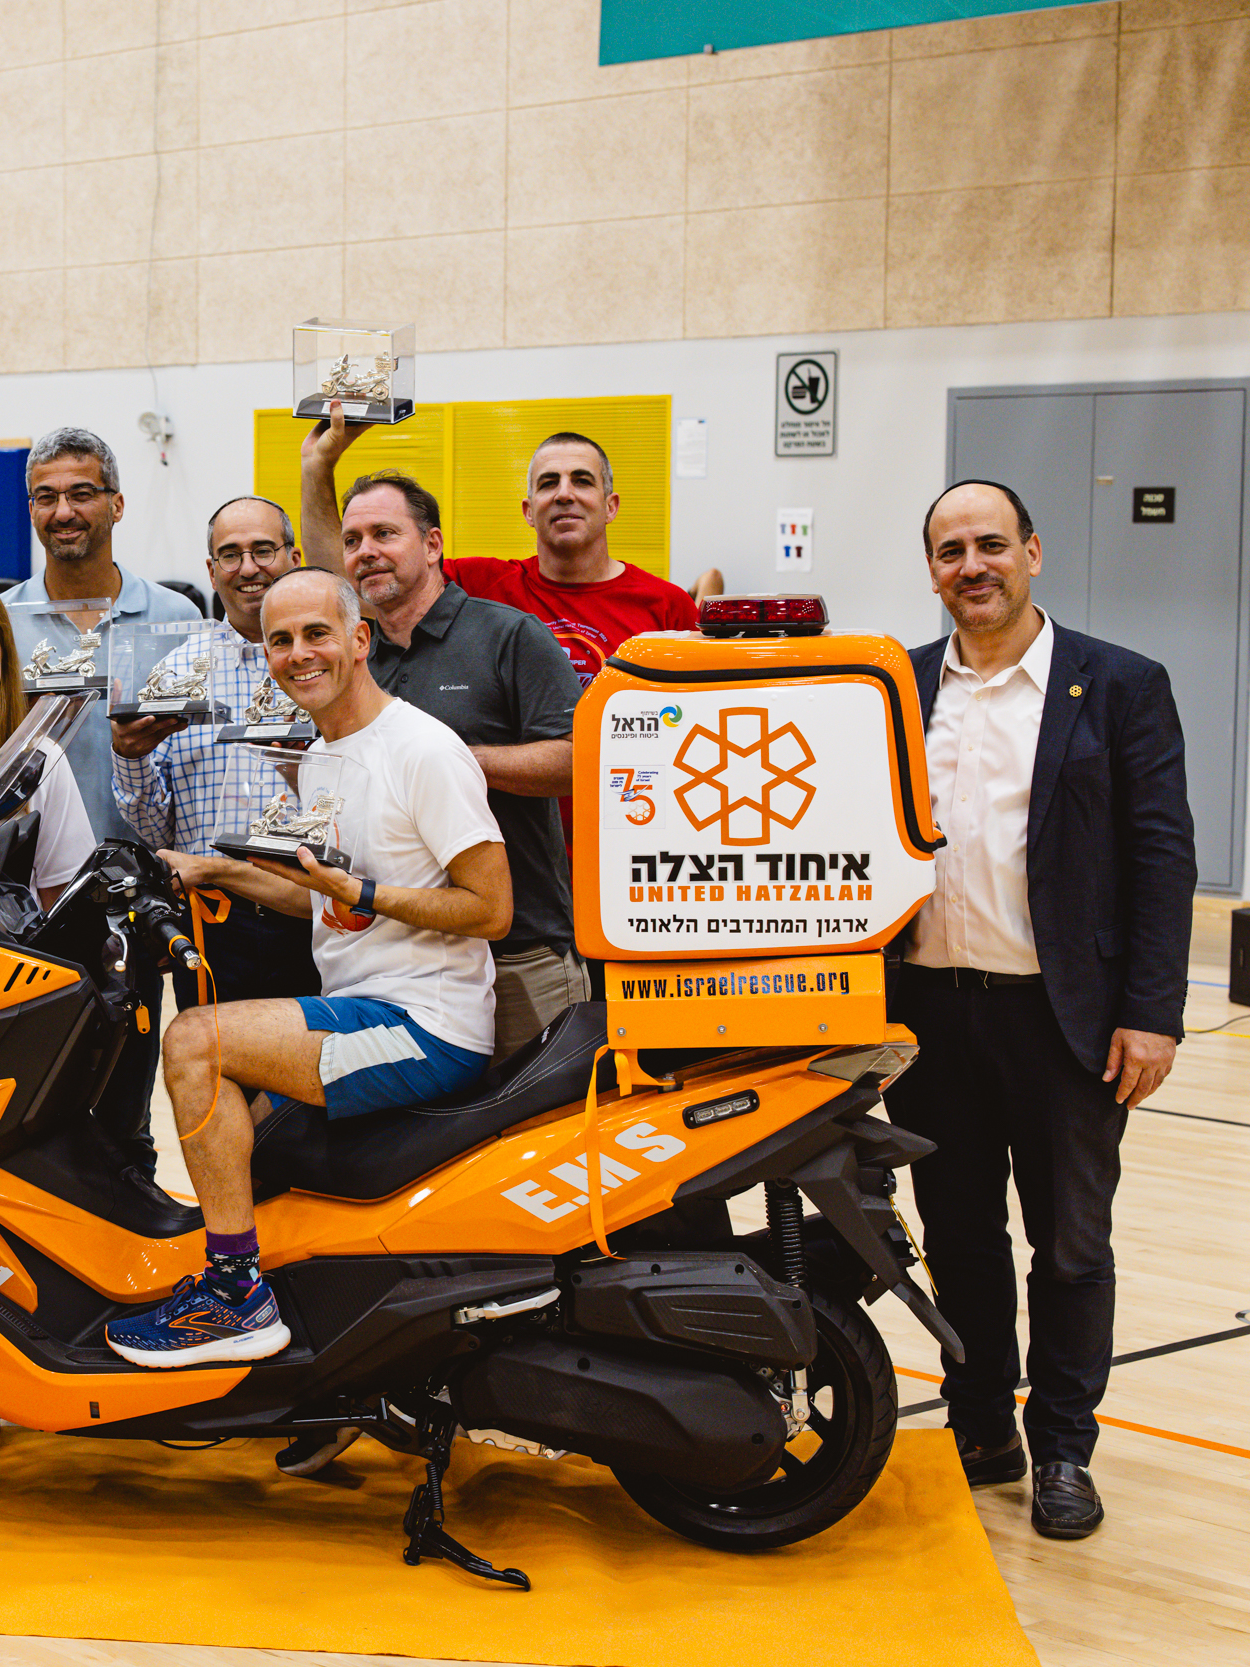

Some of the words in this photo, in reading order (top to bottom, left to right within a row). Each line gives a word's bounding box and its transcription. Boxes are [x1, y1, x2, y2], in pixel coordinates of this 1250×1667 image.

[611, 714, 659, 732] הראל
[631, 851, 744, 882] הצלה
[755, 853, 871, 881] איחוד
[629, 885, 725, 903] UNITED
[736, 884, 873, 902] HATZALAH
[627, 914, 698, 933] הלאומי
[707, 918, 808, 934] המתנדבים
[816, 918, 868, 938] ארגון
[621, 971, 850, 999] www.israelrescue.org
